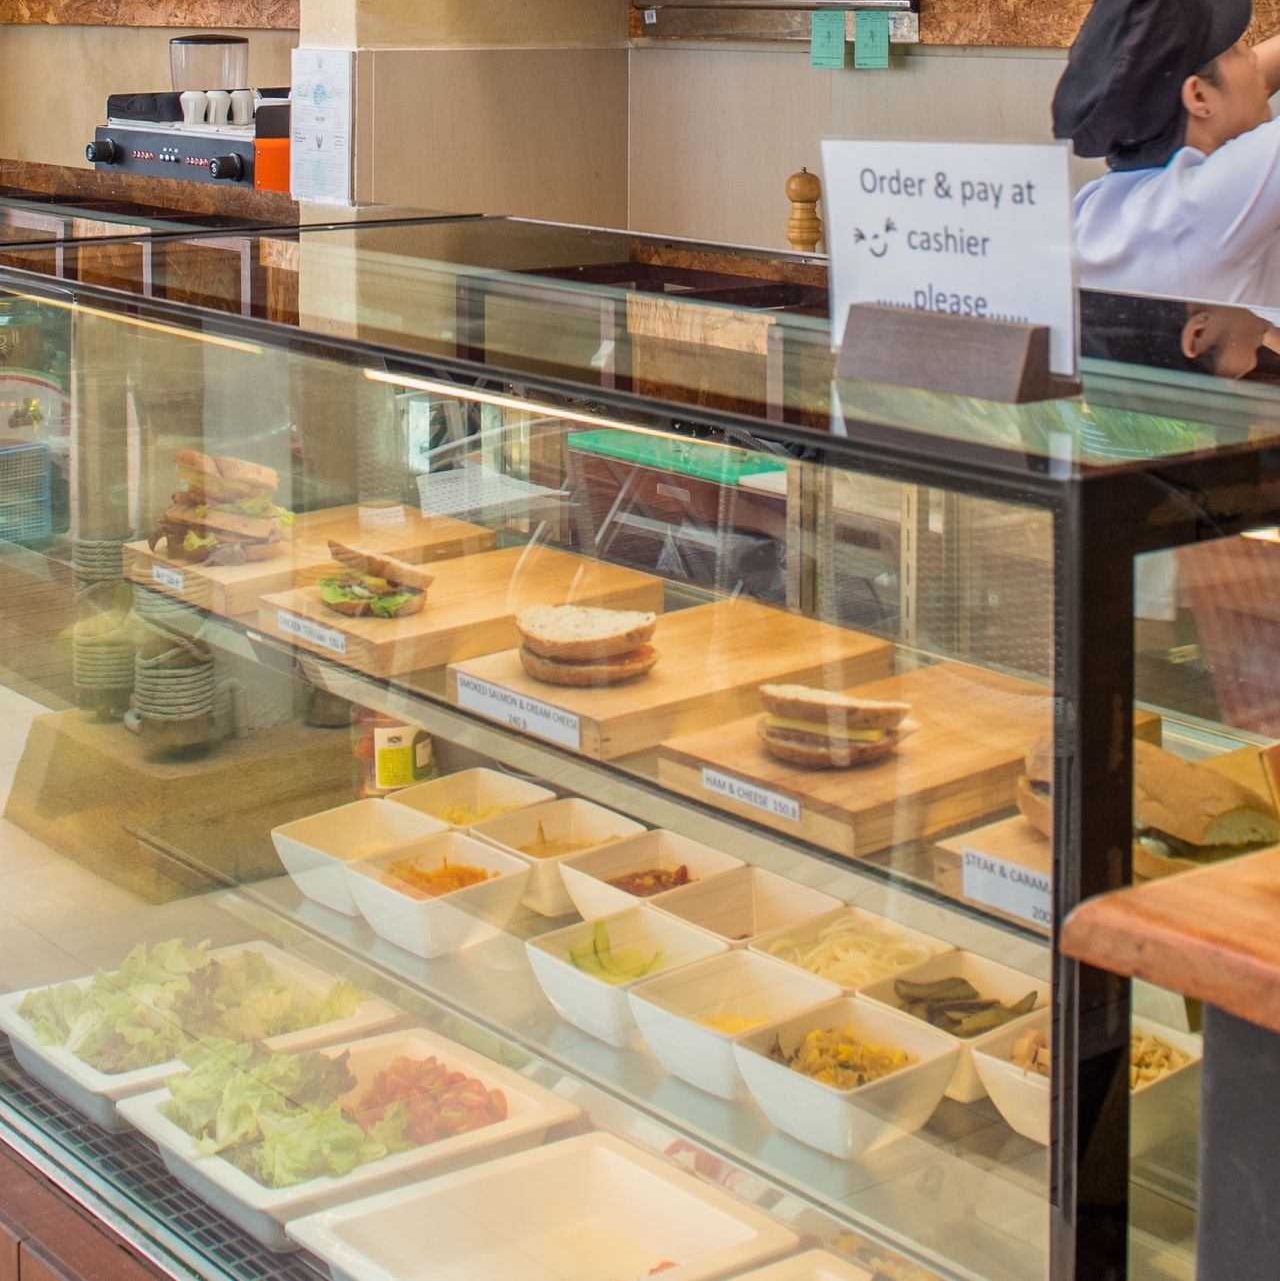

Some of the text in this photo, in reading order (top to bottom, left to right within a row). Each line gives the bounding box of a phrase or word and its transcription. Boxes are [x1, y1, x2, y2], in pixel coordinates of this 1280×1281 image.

[860, 167, 1036, 209] Order & pay at
[906, 226, 991, 257] cashier
[736, 786, 769, 808] CHEESE
[965, 852, 996, 874] STEAK
[999, 864, 1007, 879] &
